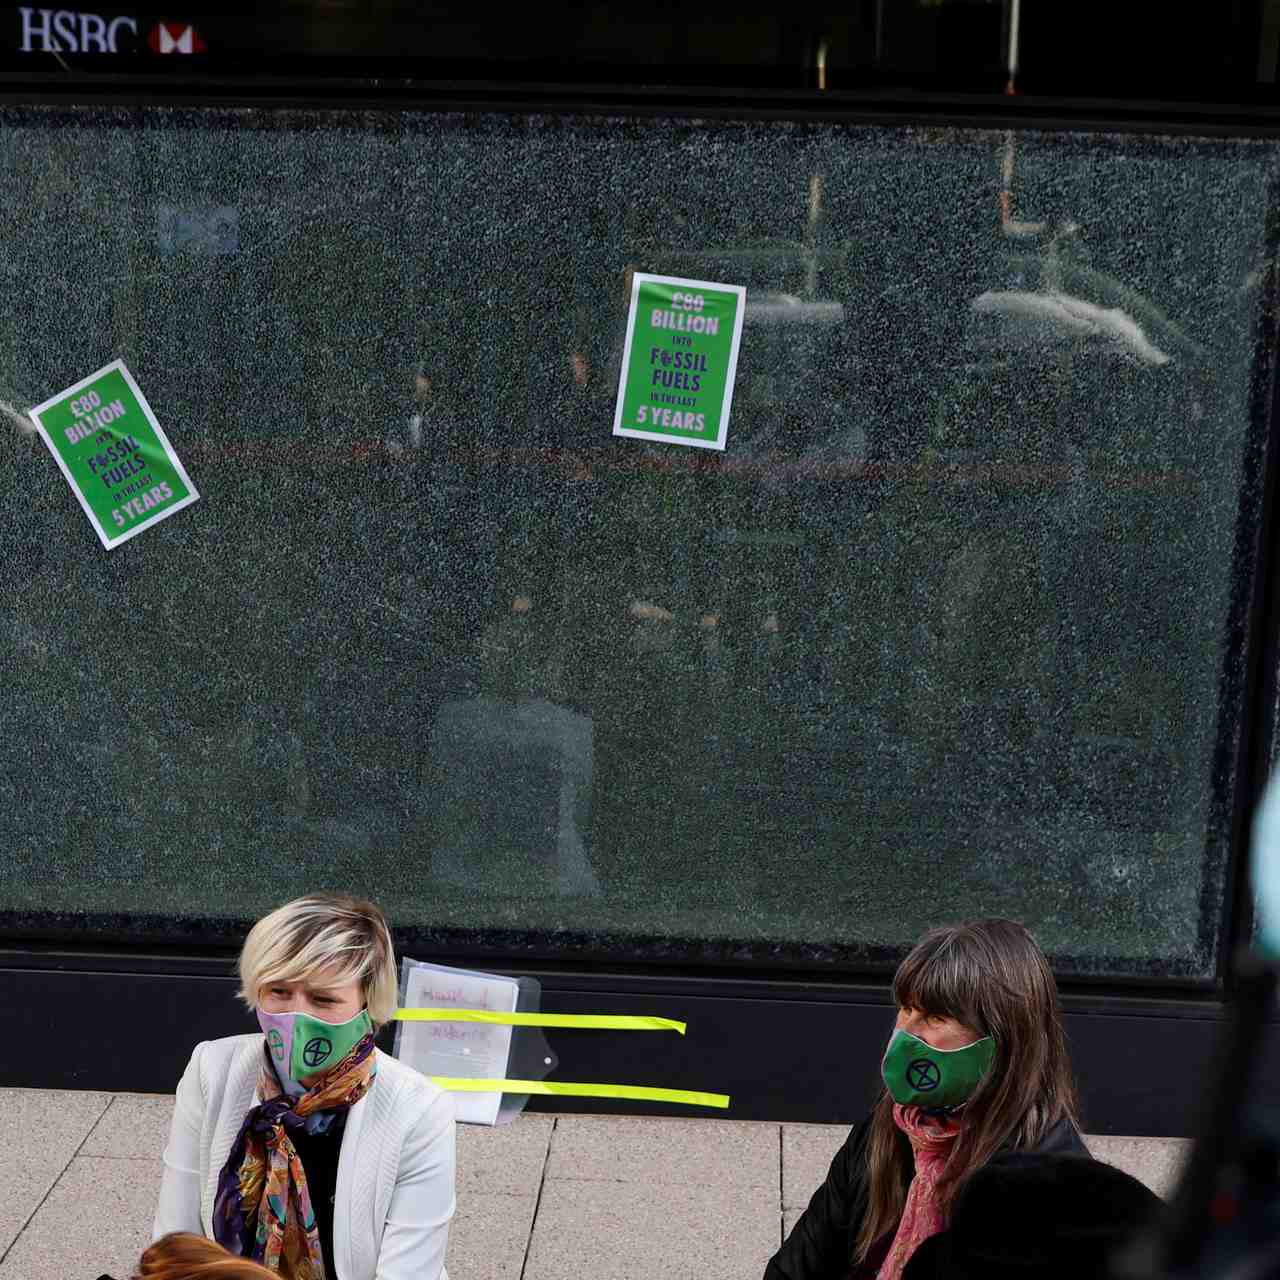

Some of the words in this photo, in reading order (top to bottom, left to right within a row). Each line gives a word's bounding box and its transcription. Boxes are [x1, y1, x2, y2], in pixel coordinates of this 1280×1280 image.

[651, 309, 719, 335] BILLION
[652, 368, 701, 392] FUELS
[63, 399, 126, 445] BILLION
[636, 405, 648, 424] 5
[650, 406, 705, 432] YEARS
[101, 454, 146, 489] FUELS
[111, 508, 125, 528] 5
[121, 480, 174, 520] YEARS
